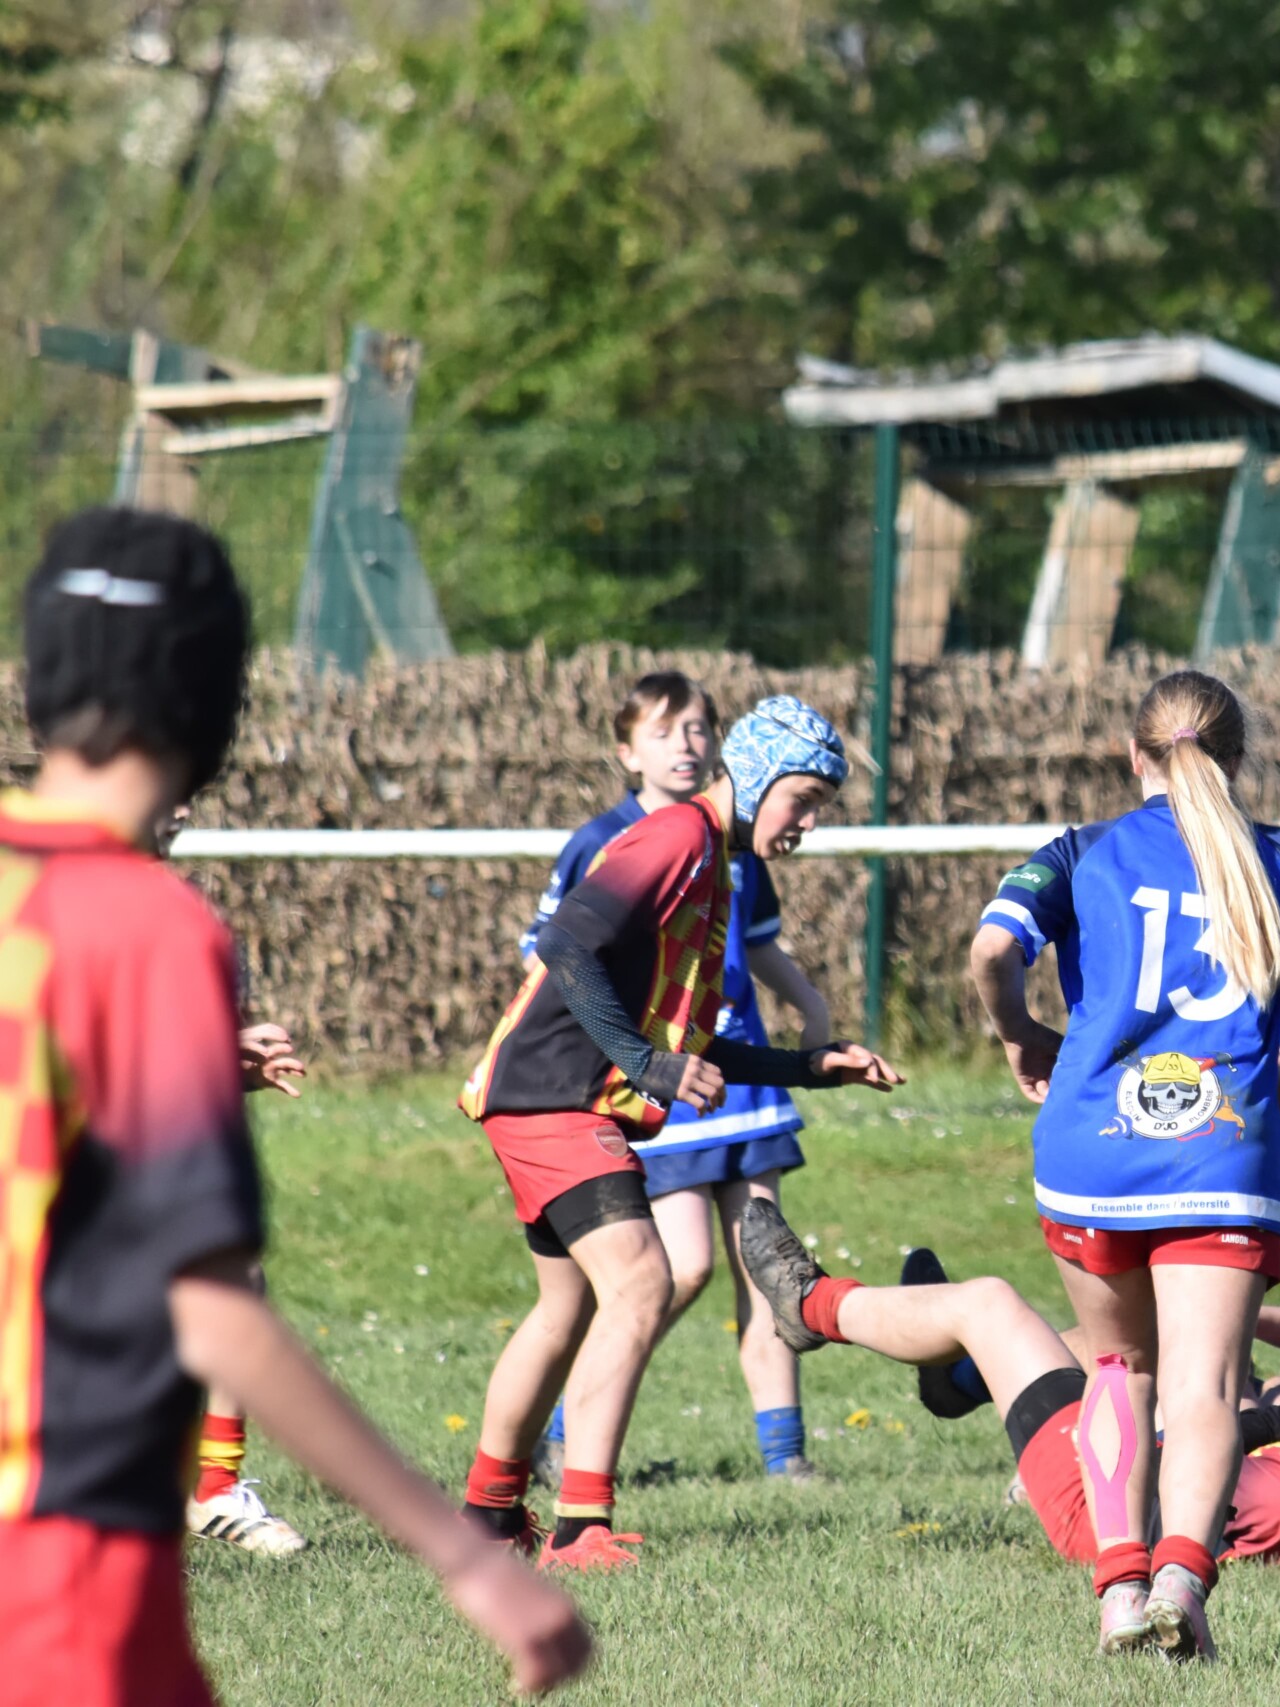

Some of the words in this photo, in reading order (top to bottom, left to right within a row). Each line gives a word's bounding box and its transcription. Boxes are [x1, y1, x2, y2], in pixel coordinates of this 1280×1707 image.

[1130, 886, 1248, 1022] 13
[1153, 1122, 1178, 1131] D'JO
[1091, 1203, 1143, 1212] Ensemble
[1221, 1233, 1249, 1246] LANGON
